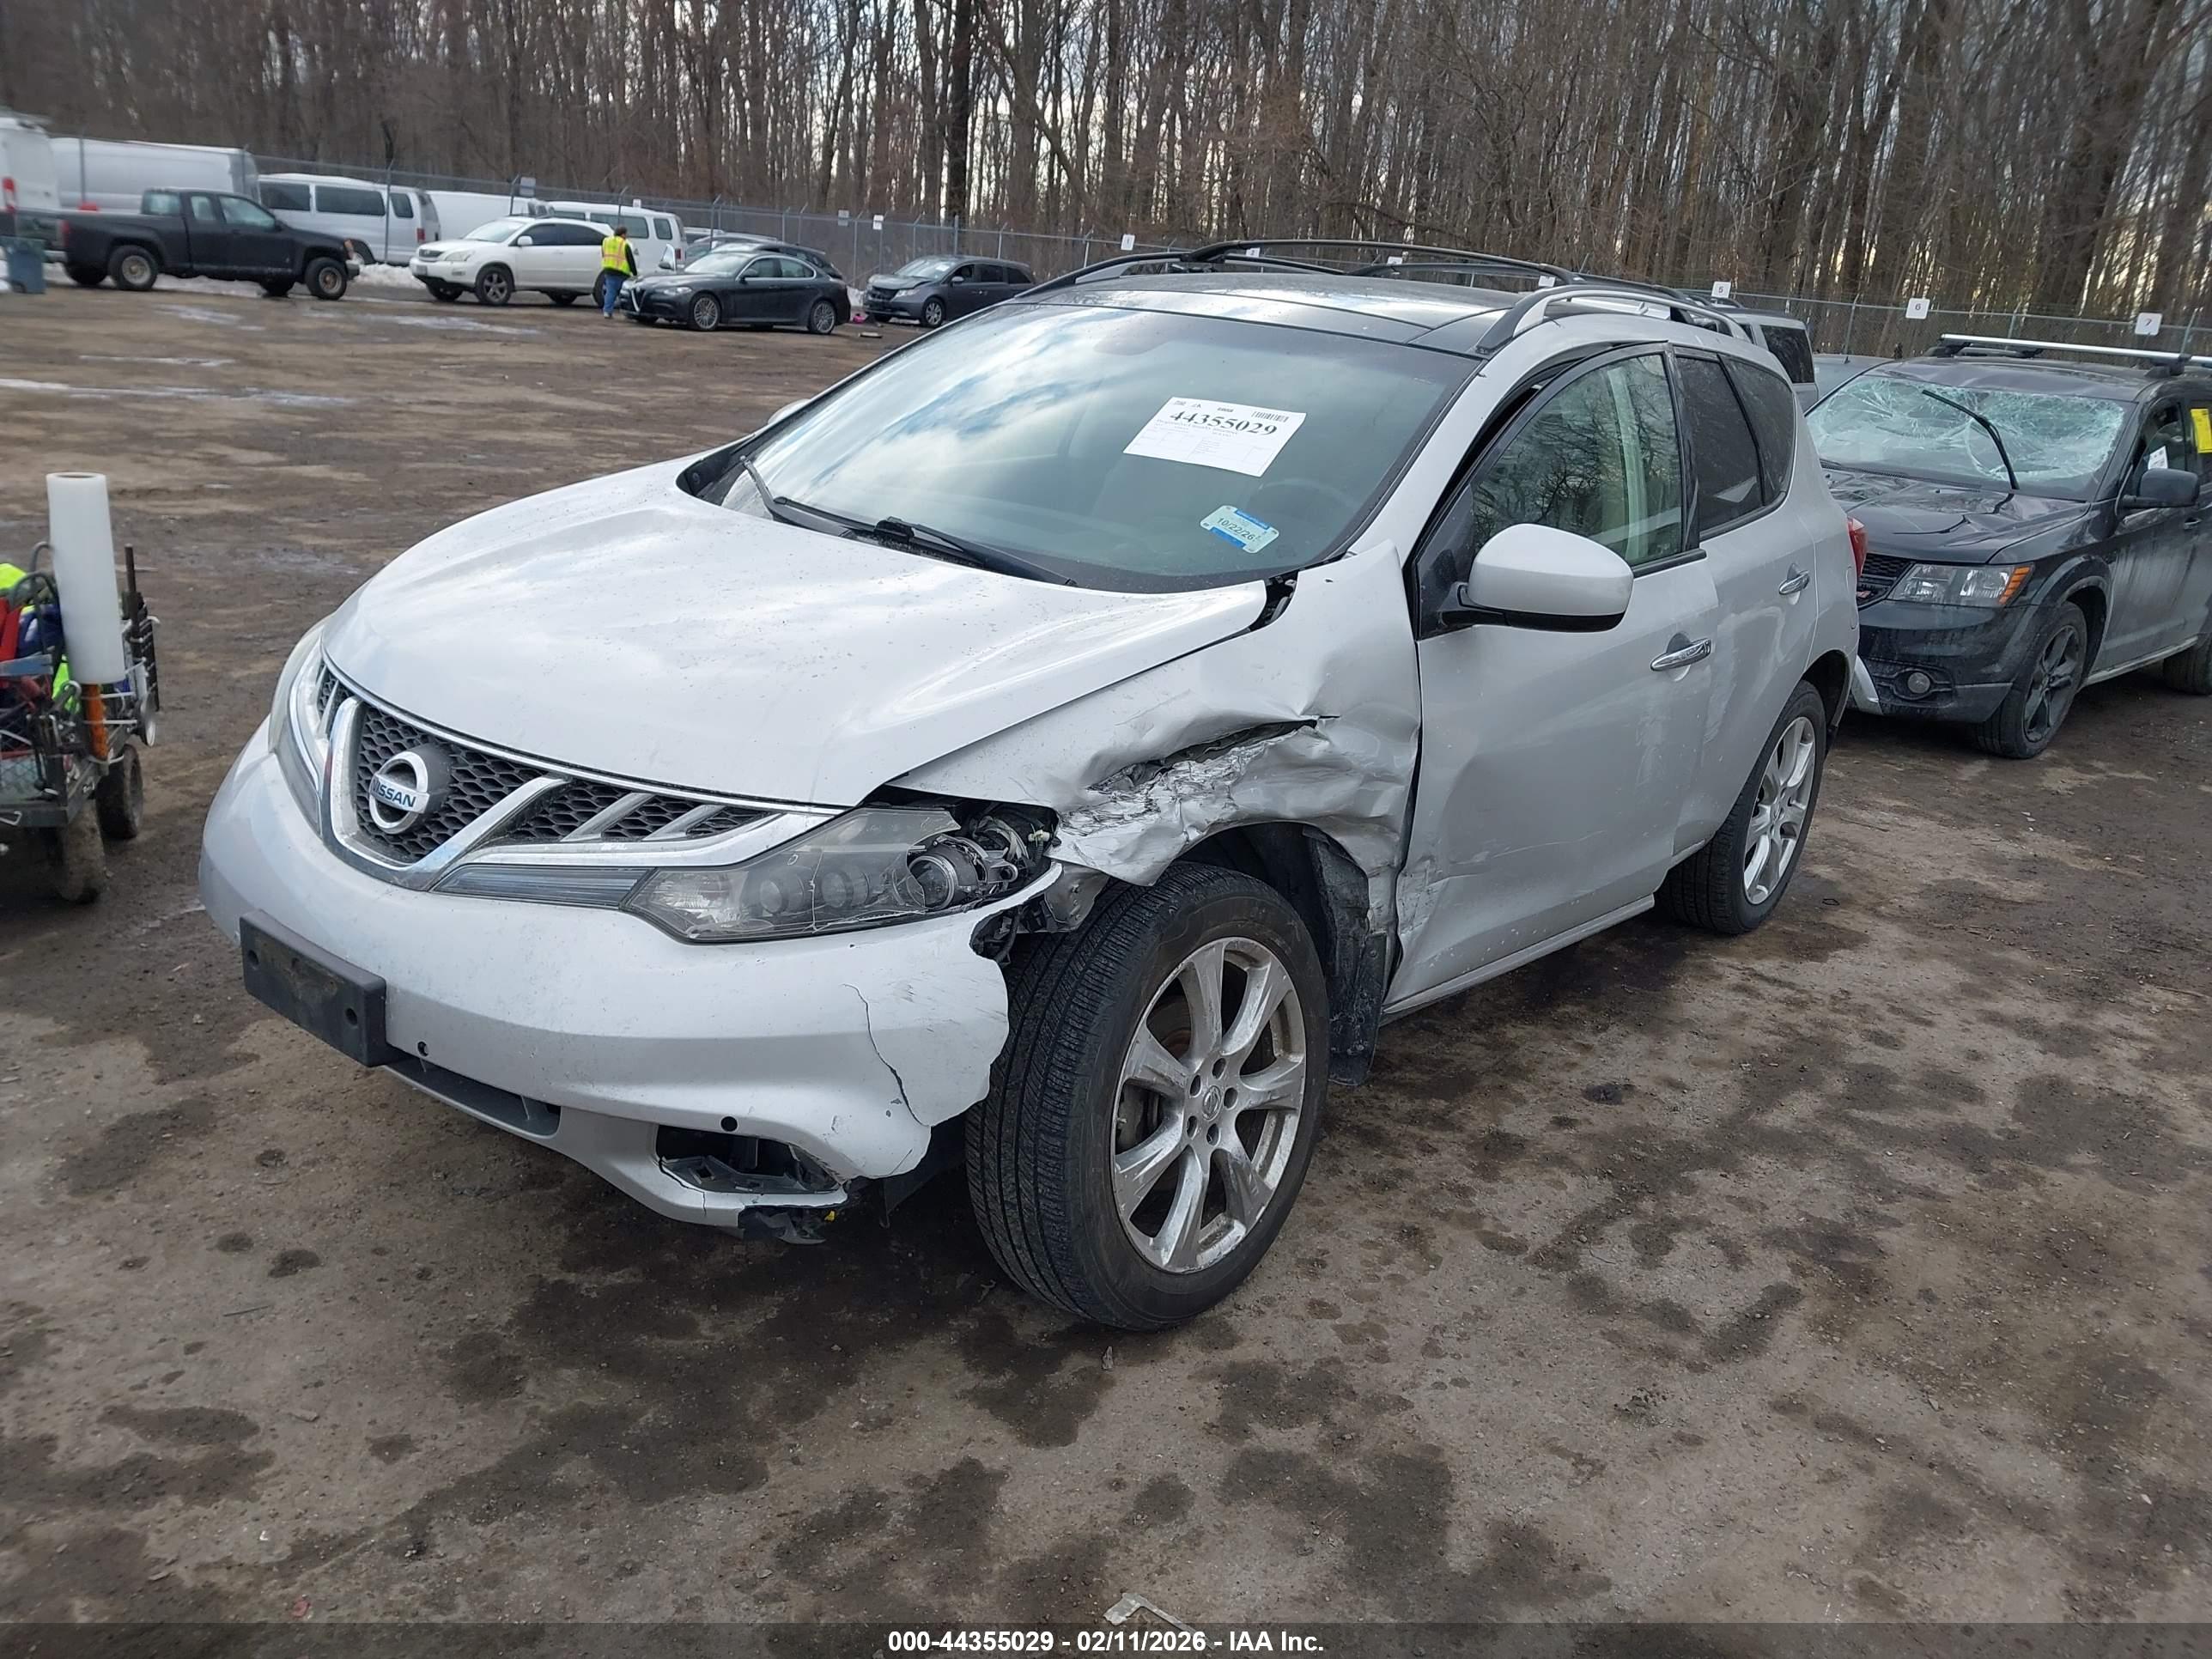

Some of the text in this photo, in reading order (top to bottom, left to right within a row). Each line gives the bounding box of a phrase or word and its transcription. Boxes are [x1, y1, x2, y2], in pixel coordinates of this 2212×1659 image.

[1170, 410, 1277, 435] 44355029
[1217, 517, 1255, 540] 10/22/26
[371, 778, 416, 807] NISSAN
